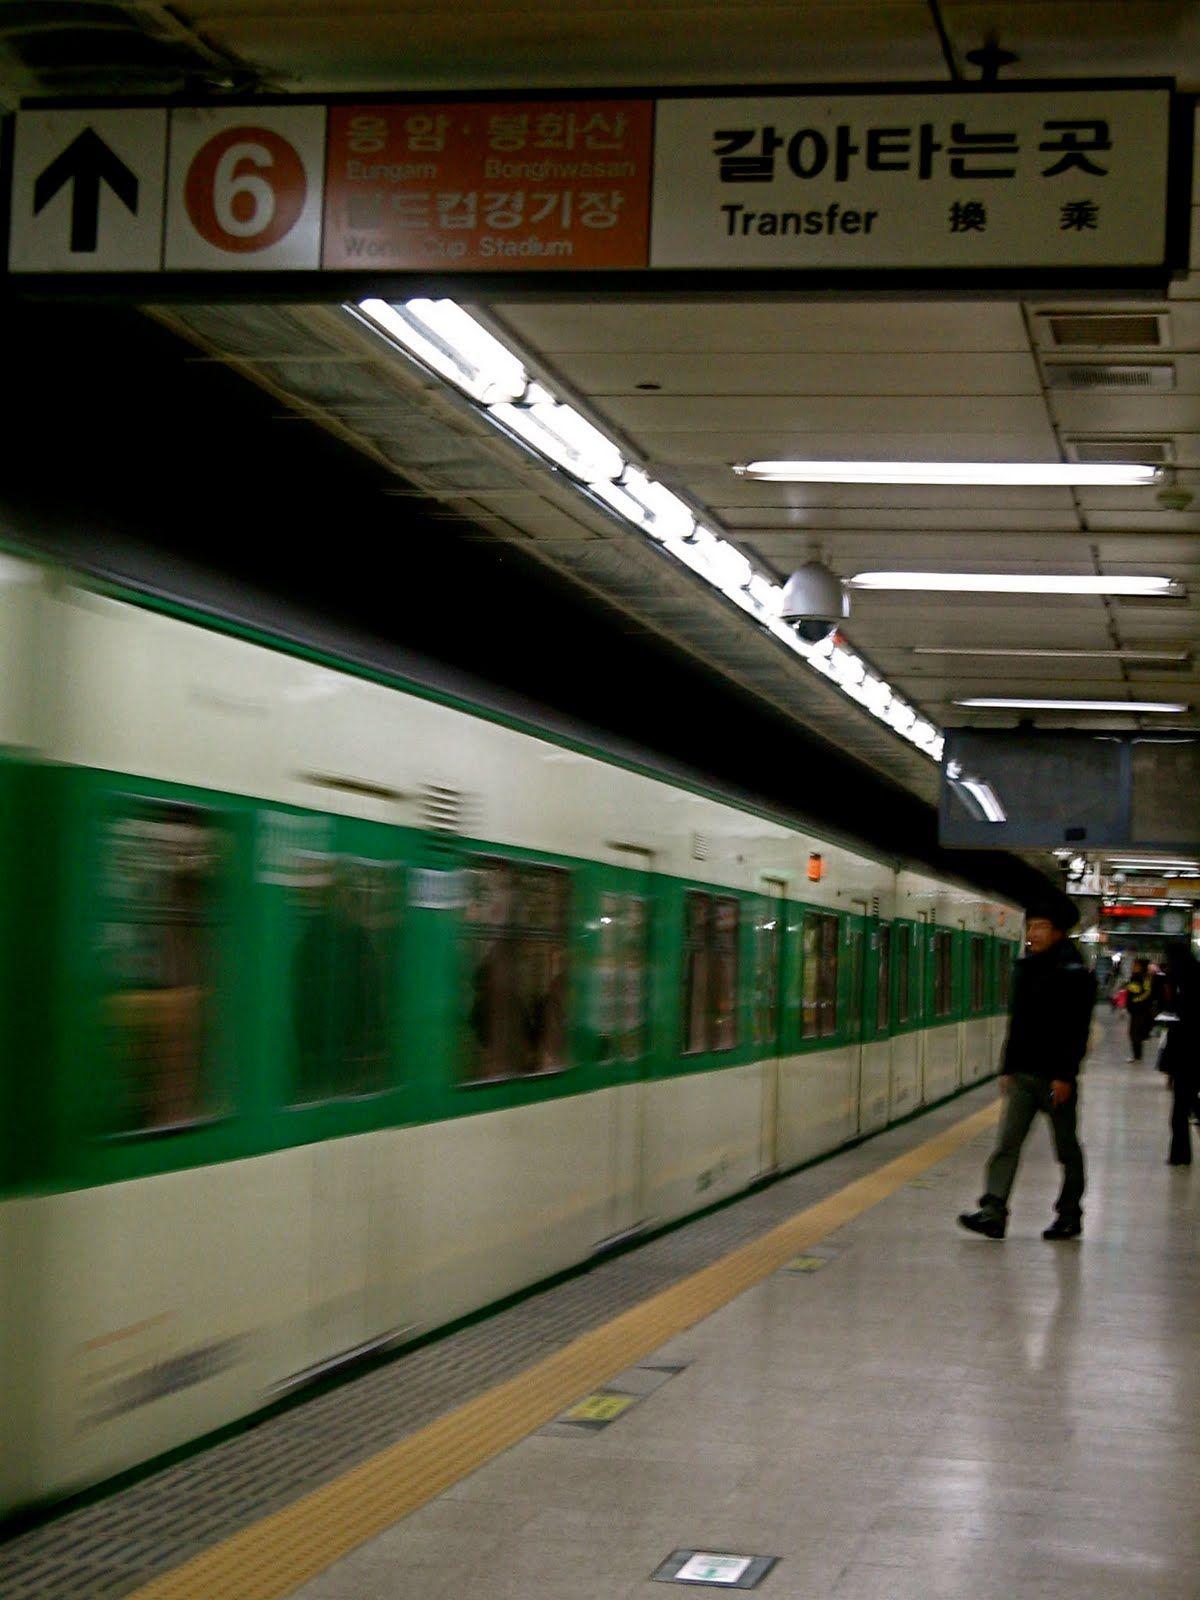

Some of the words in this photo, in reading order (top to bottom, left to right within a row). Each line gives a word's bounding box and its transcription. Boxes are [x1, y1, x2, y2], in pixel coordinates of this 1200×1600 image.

[488, 111, 629, 152] 봉화산
[712, 122, 1020, 183] 갈아타는
[1038, 120, 1114, 178] 곳
[212, 142, 274, 237] 6
[346, 160, 437, 181] Eungam
[485, 158, 637, 181] Bonghwasan
[346, 190, 625, 230] 드컵경기장
[721, 203, 879, 237] Transfer
[479, 234, 573, 257] Stadium
